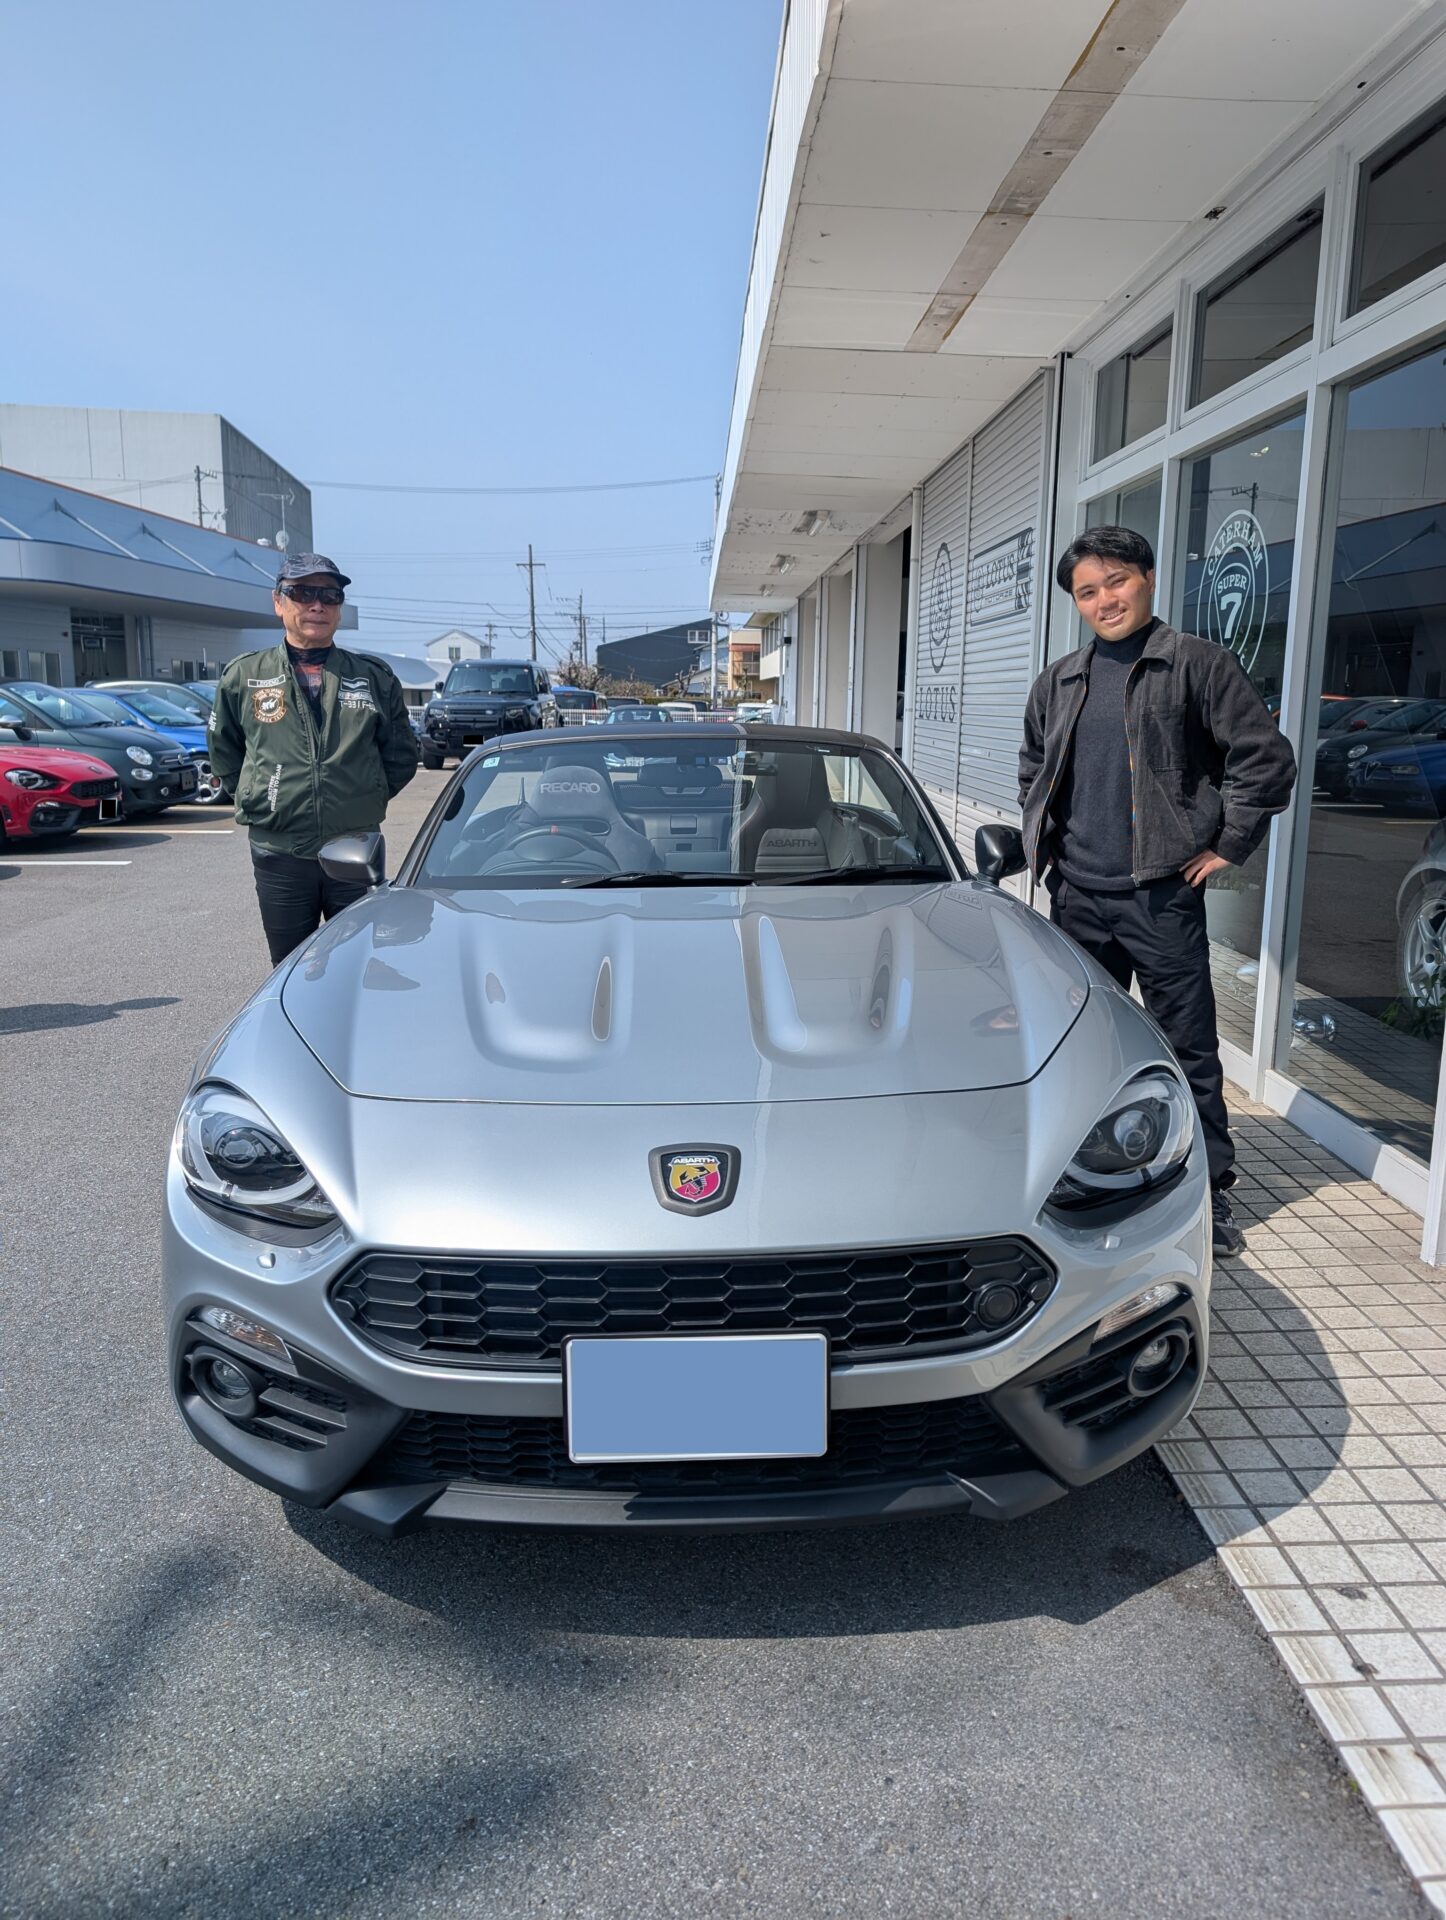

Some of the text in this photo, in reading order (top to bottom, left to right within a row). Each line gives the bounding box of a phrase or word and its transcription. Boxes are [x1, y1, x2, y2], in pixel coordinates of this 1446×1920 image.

[1207, 520, 1264, 577] CATERHAM
[983, 553, 1016, 590] LOTUS
[1217, 573, 1248, 595] SUPER
[1220, 592, 1243, 639] 7
[918, 686, 956, 723] LOTUS
[540, 781, 601, 793] RECARO
[767, 838, 817, 848] ABARTH
